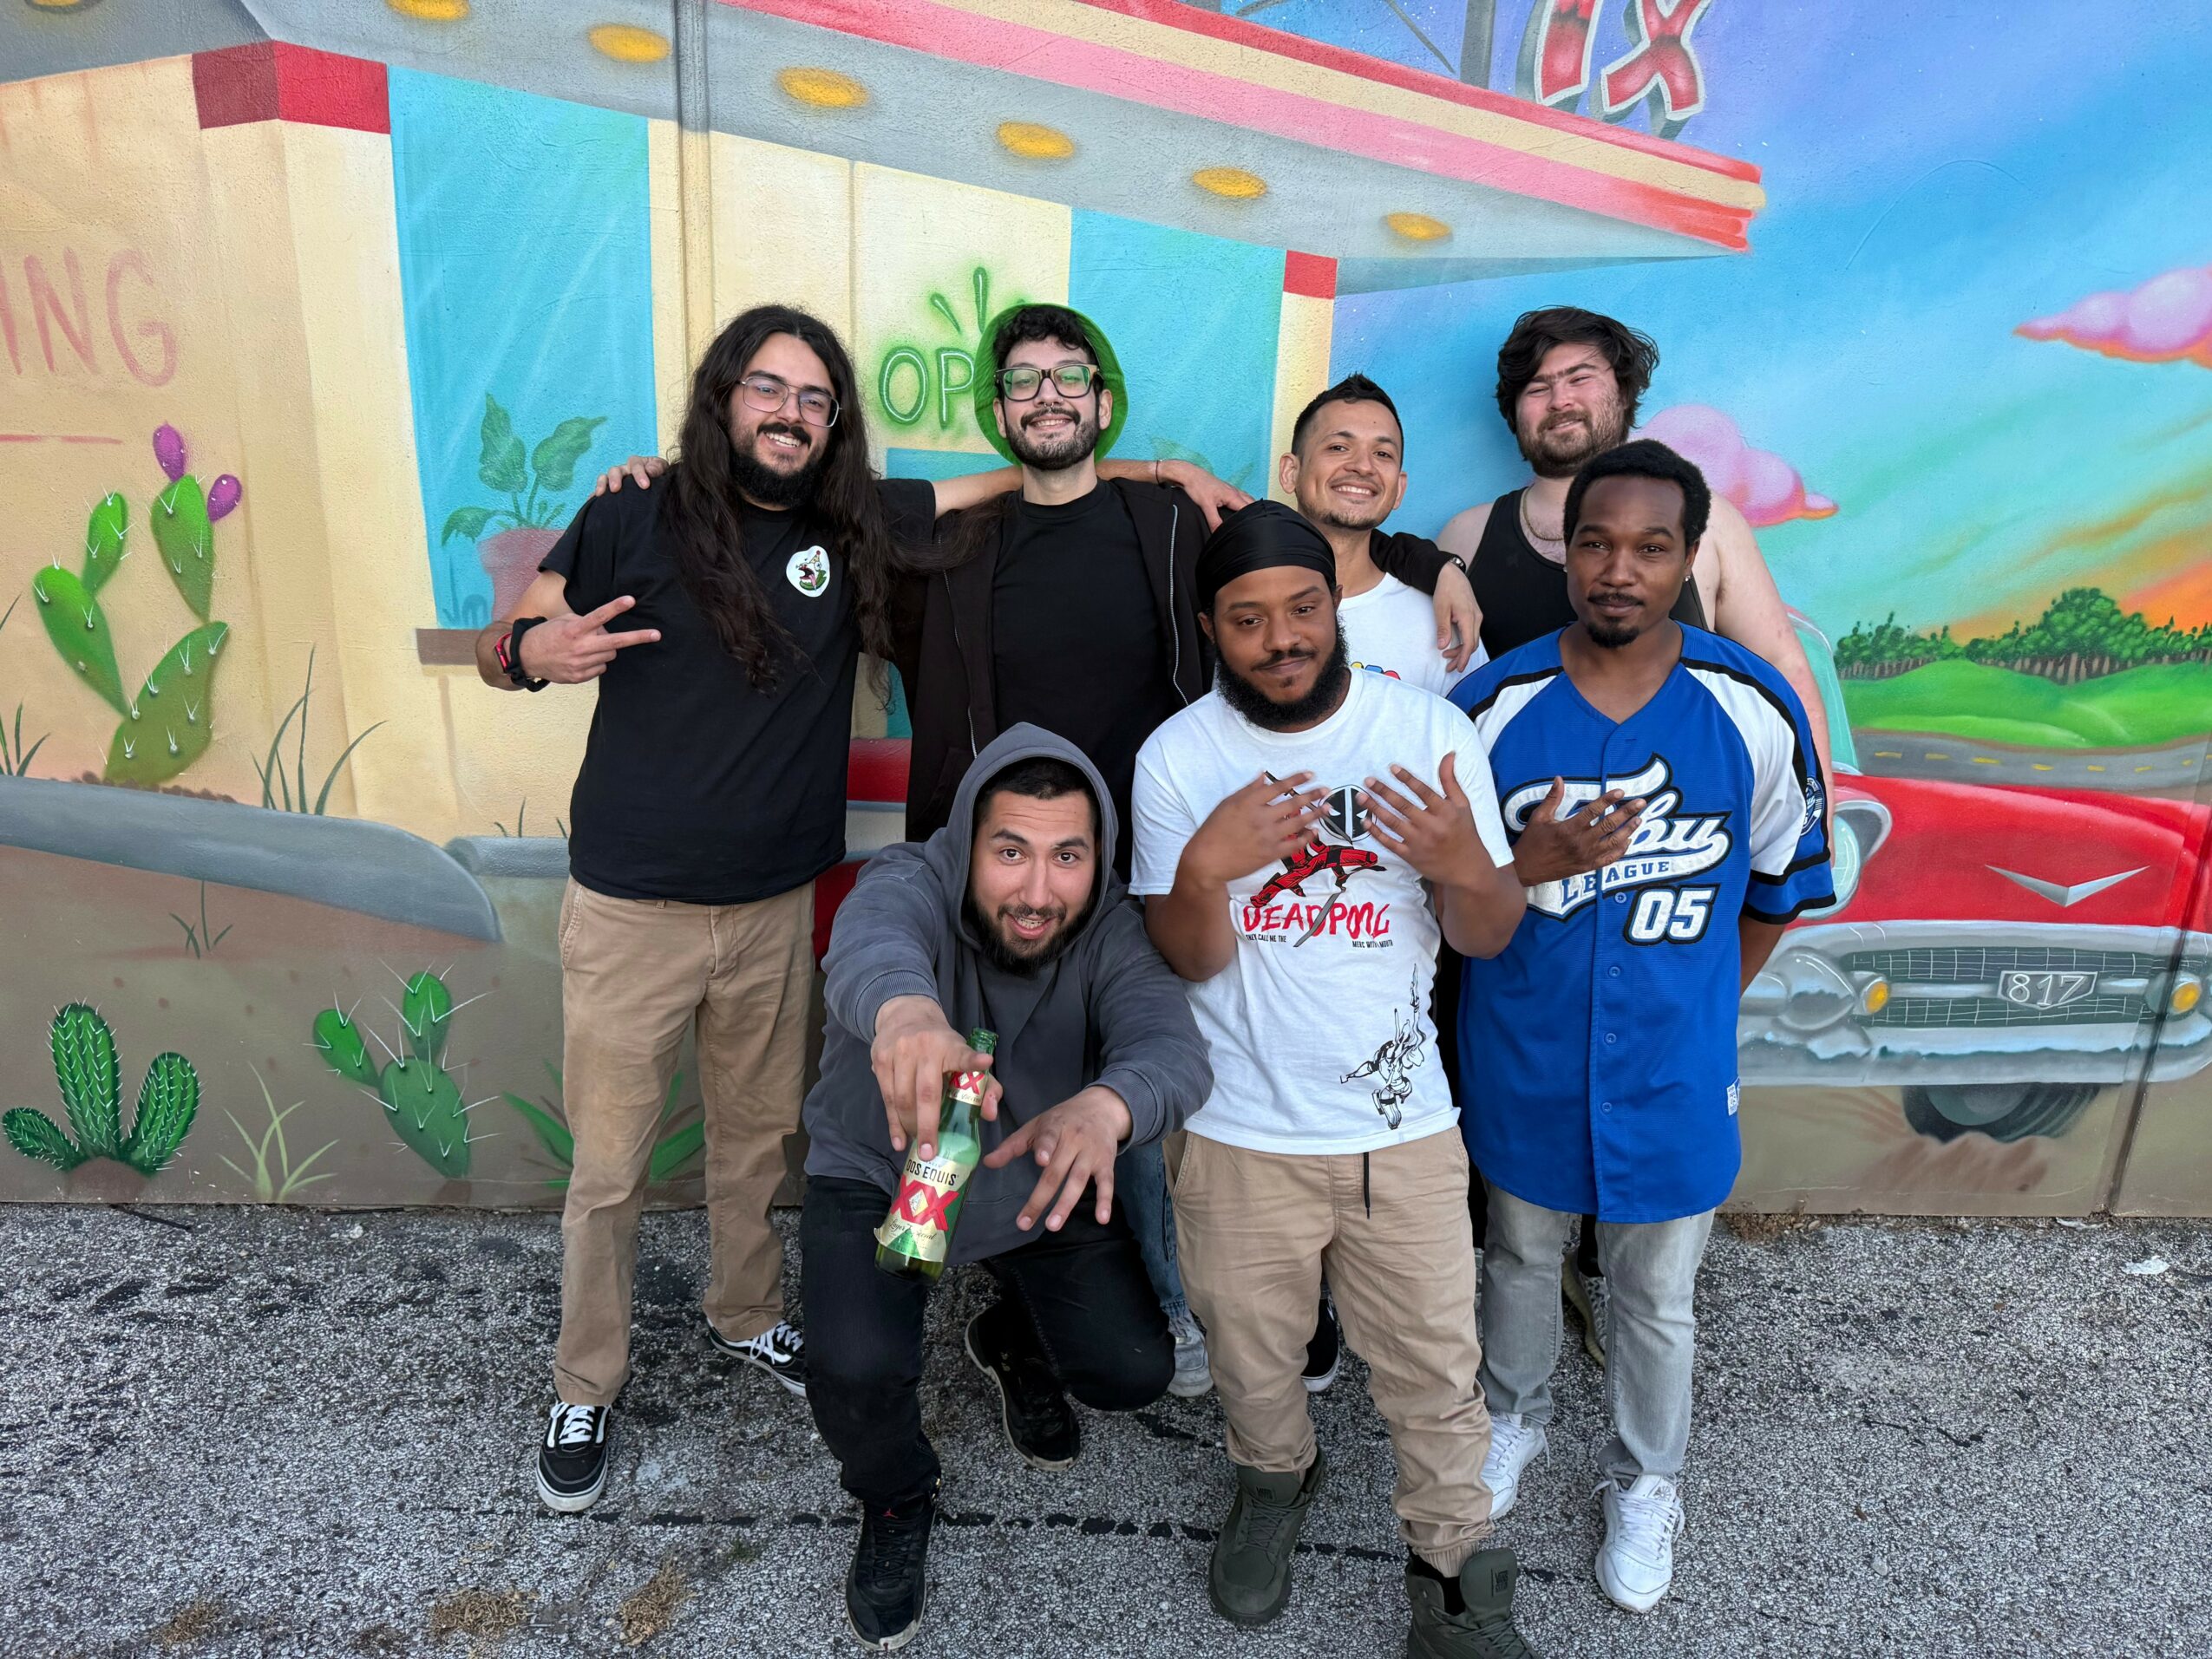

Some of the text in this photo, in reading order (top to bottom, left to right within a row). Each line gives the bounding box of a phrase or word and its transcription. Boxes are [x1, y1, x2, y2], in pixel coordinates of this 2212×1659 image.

[1501, 752, 1733, 856] Fbu
[1561, 860, 1670, 905] LEAGUE
[1624, 883, 1721, 946] 05
[2009, 973, 2085, 1006] 817
[906, 1159, 957, 1186] DOS EQUIS
[890, 1174, 959, 1231] XX
